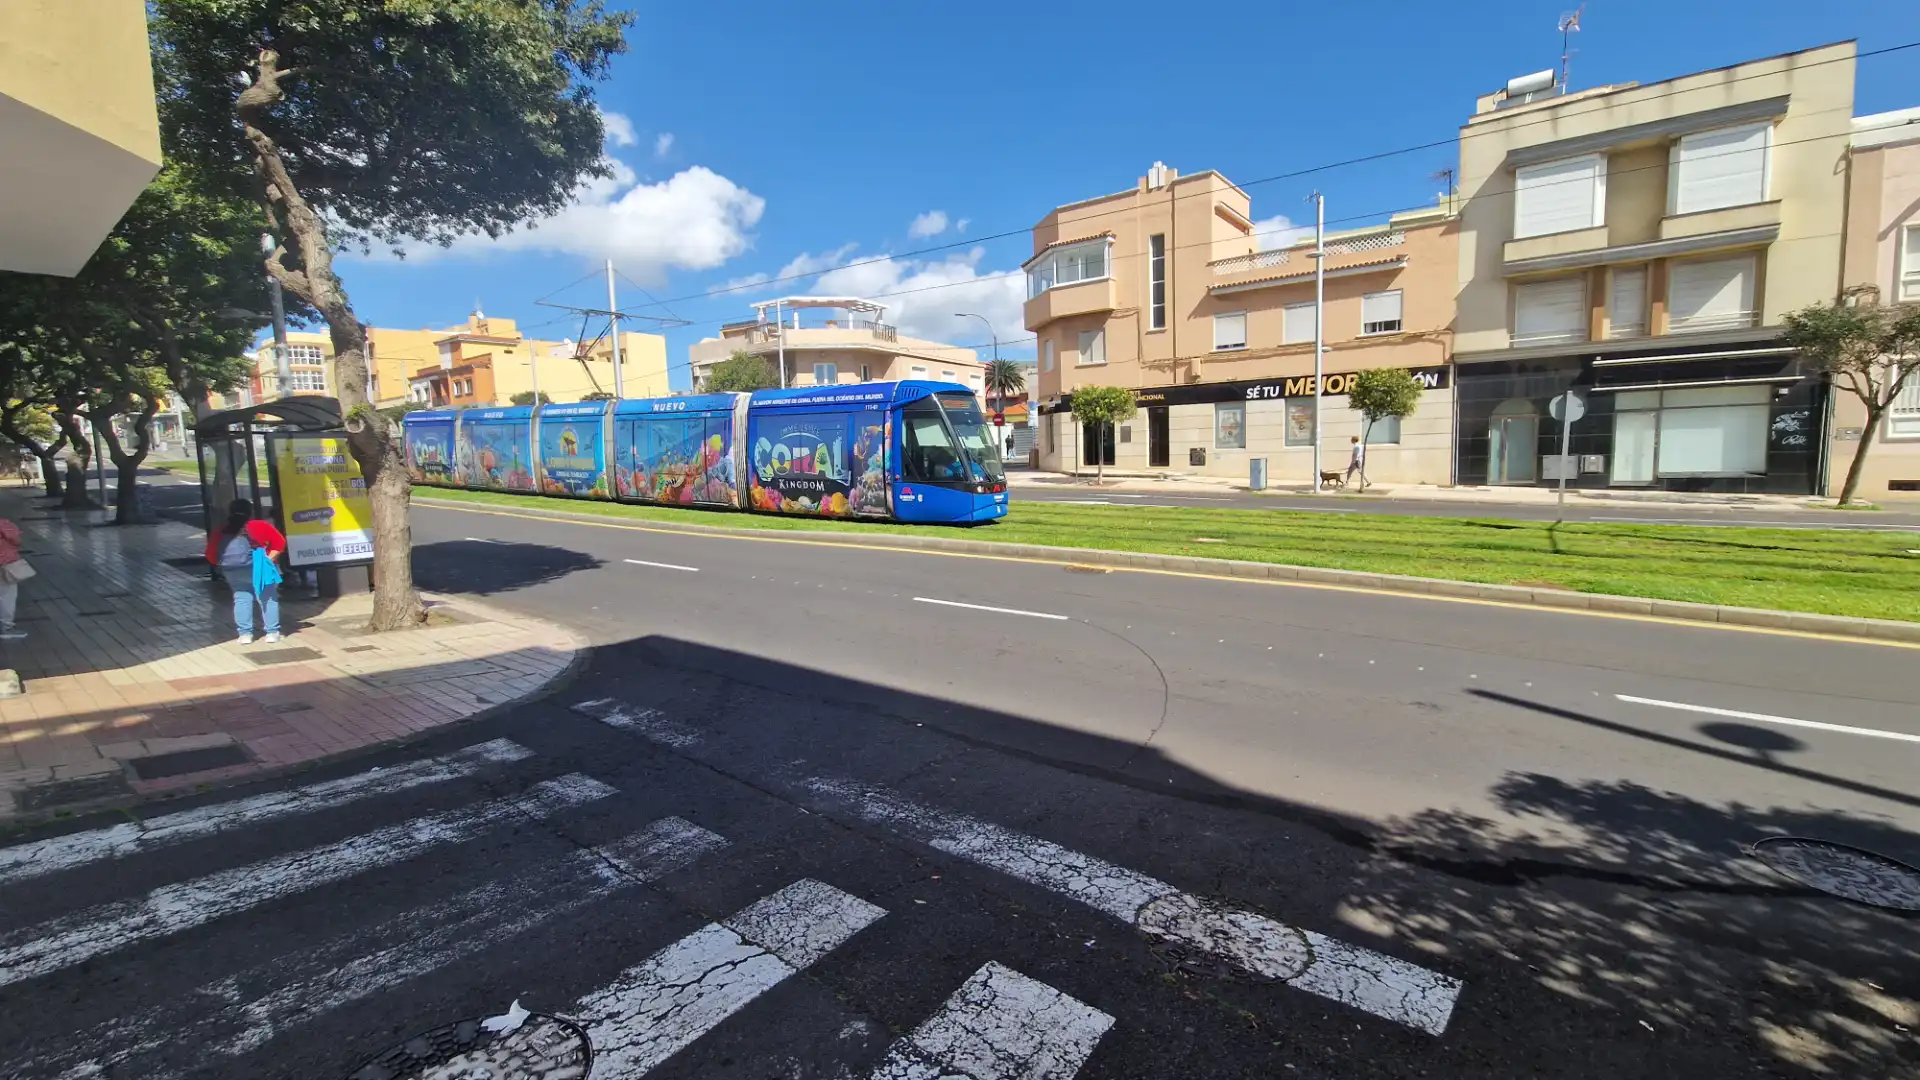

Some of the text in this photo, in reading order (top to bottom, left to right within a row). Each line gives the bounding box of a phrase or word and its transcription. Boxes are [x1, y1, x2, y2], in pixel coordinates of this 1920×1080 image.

[1245, 374, 1359, 399] SÉ TU MEJOR
[653, 401, 686, 411] NUEVO
[754, 436, 851, 486] CORAL
[778, 479, 825, 491] KINGDOM
[297, 546, 341, 558] PUBLICIDAD
